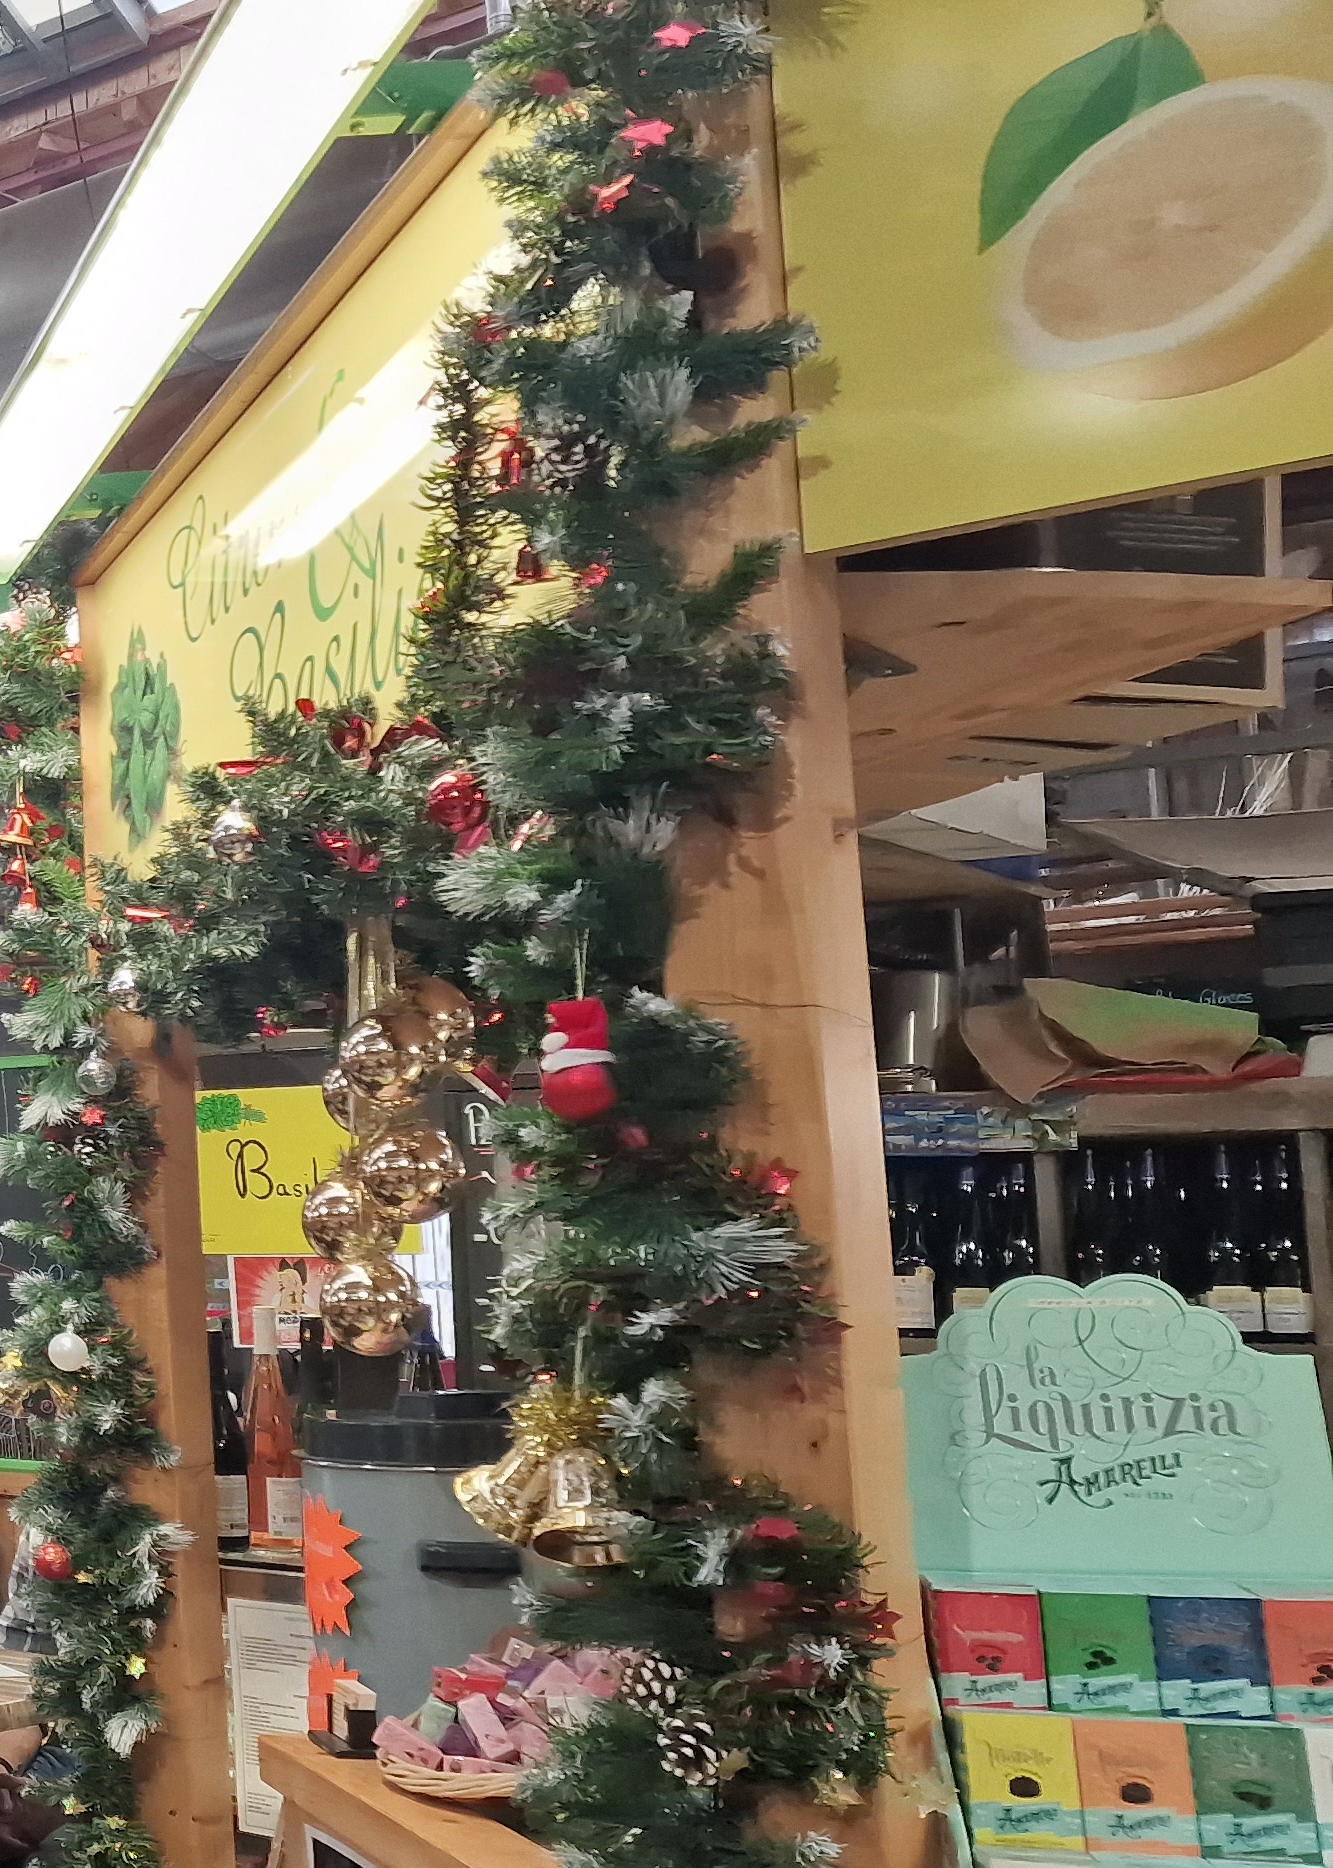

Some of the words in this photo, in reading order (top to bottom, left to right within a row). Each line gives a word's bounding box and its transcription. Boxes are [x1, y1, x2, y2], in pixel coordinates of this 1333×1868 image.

[226, 1138, 320, 1200] Basil
[1025, 1343, 1062, 1391] la
[976, 1363, 1245, 1453] Liquirizia
[1036, 1452, 1184, 1510] AMARELLI
